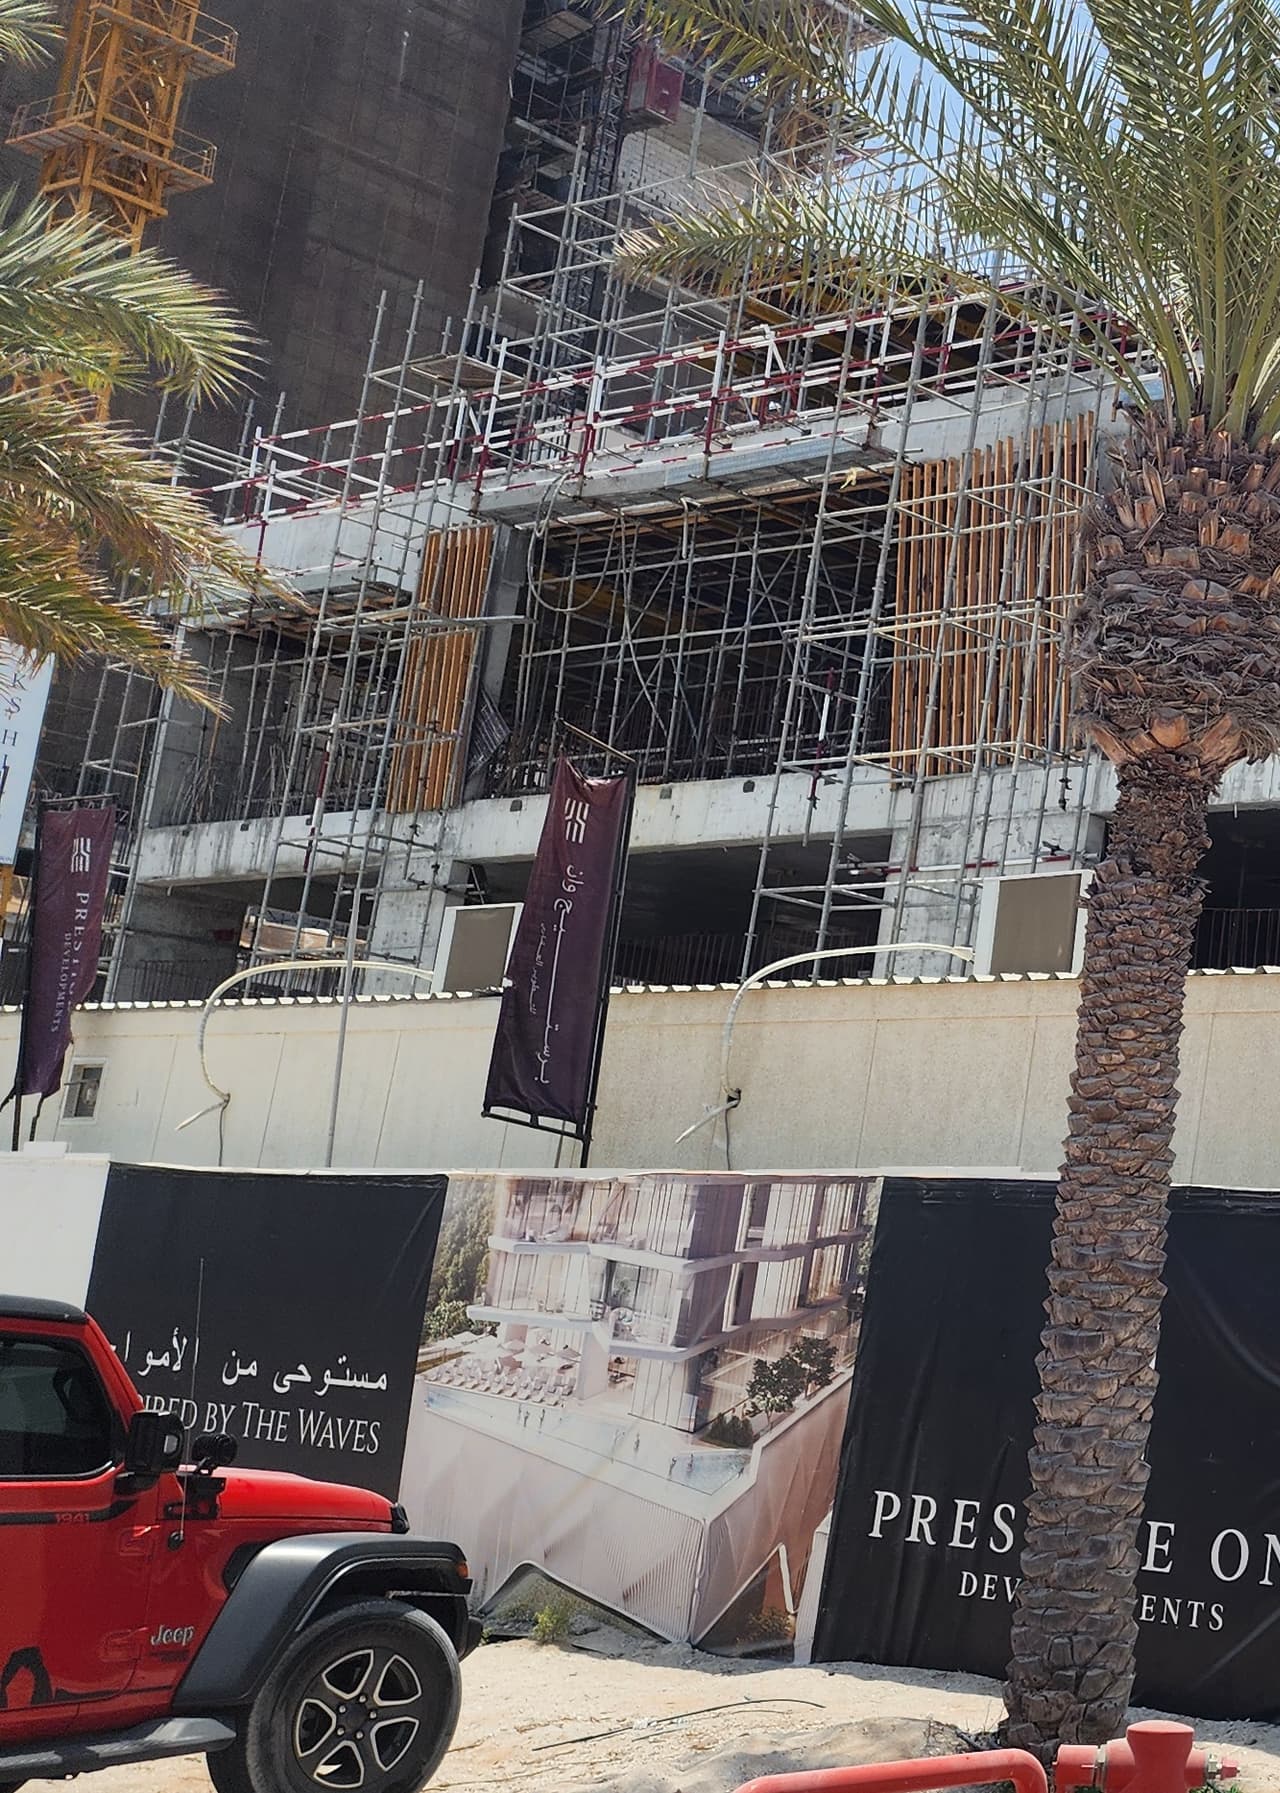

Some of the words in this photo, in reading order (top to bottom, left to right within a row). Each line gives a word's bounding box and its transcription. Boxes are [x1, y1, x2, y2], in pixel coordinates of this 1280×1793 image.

[51, 932, 72, 1032] DEVELOPMENTS
[221, 1350, 258, 1386] من
[203, 1402, 236, 1436] BY
[868, 1489, 1177, 1575] PRESE
[958, 1569, 1225, 1633] DEVENTS
[150, 1624, 195, 1646] Jeep
